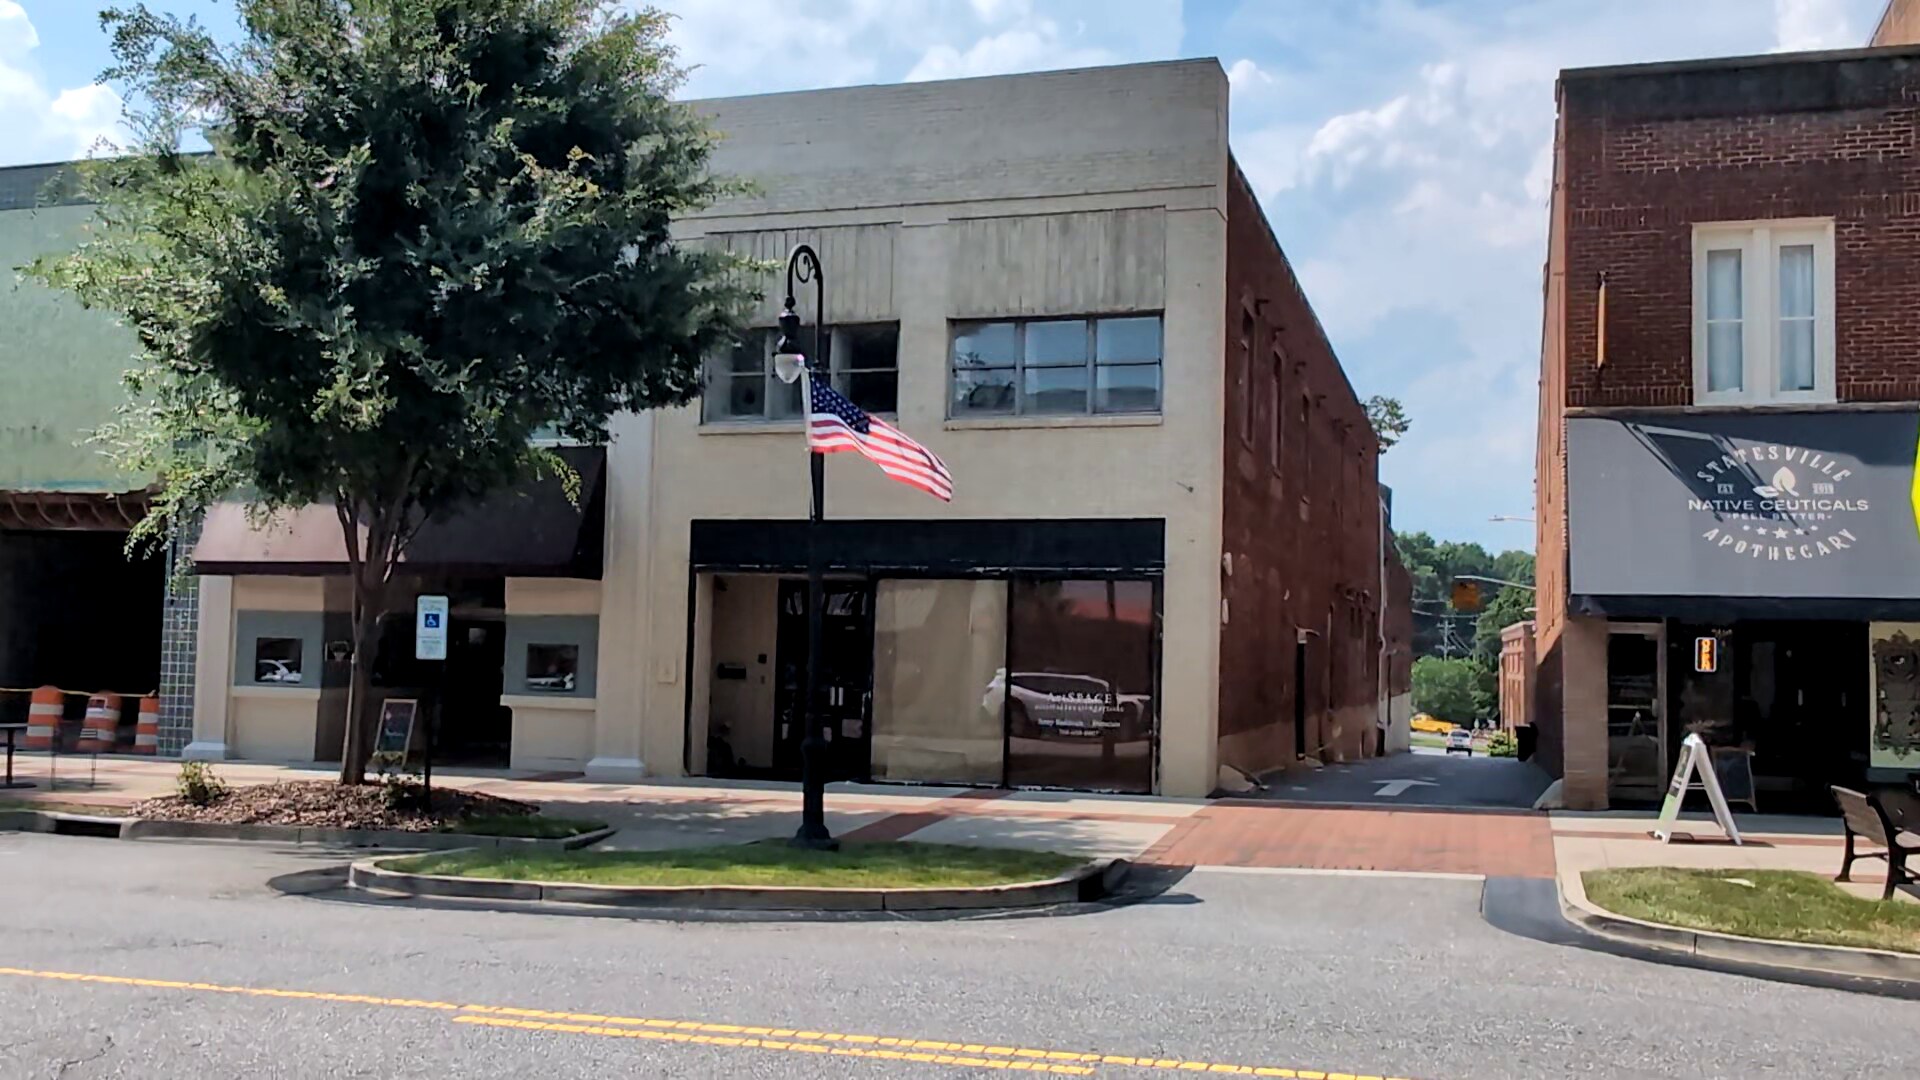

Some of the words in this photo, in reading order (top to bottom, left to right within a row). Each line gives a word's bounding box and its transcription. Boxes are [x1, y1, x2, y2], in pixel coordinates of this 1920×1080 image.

[1697, 445, 1852, 483] STATESVILLE
[1688, 499, 1754, 511] NATIVE
[1759, 499, 1869, 511] CEUTICALS
[1702, 528, 1857, 561] APOTHECARY
